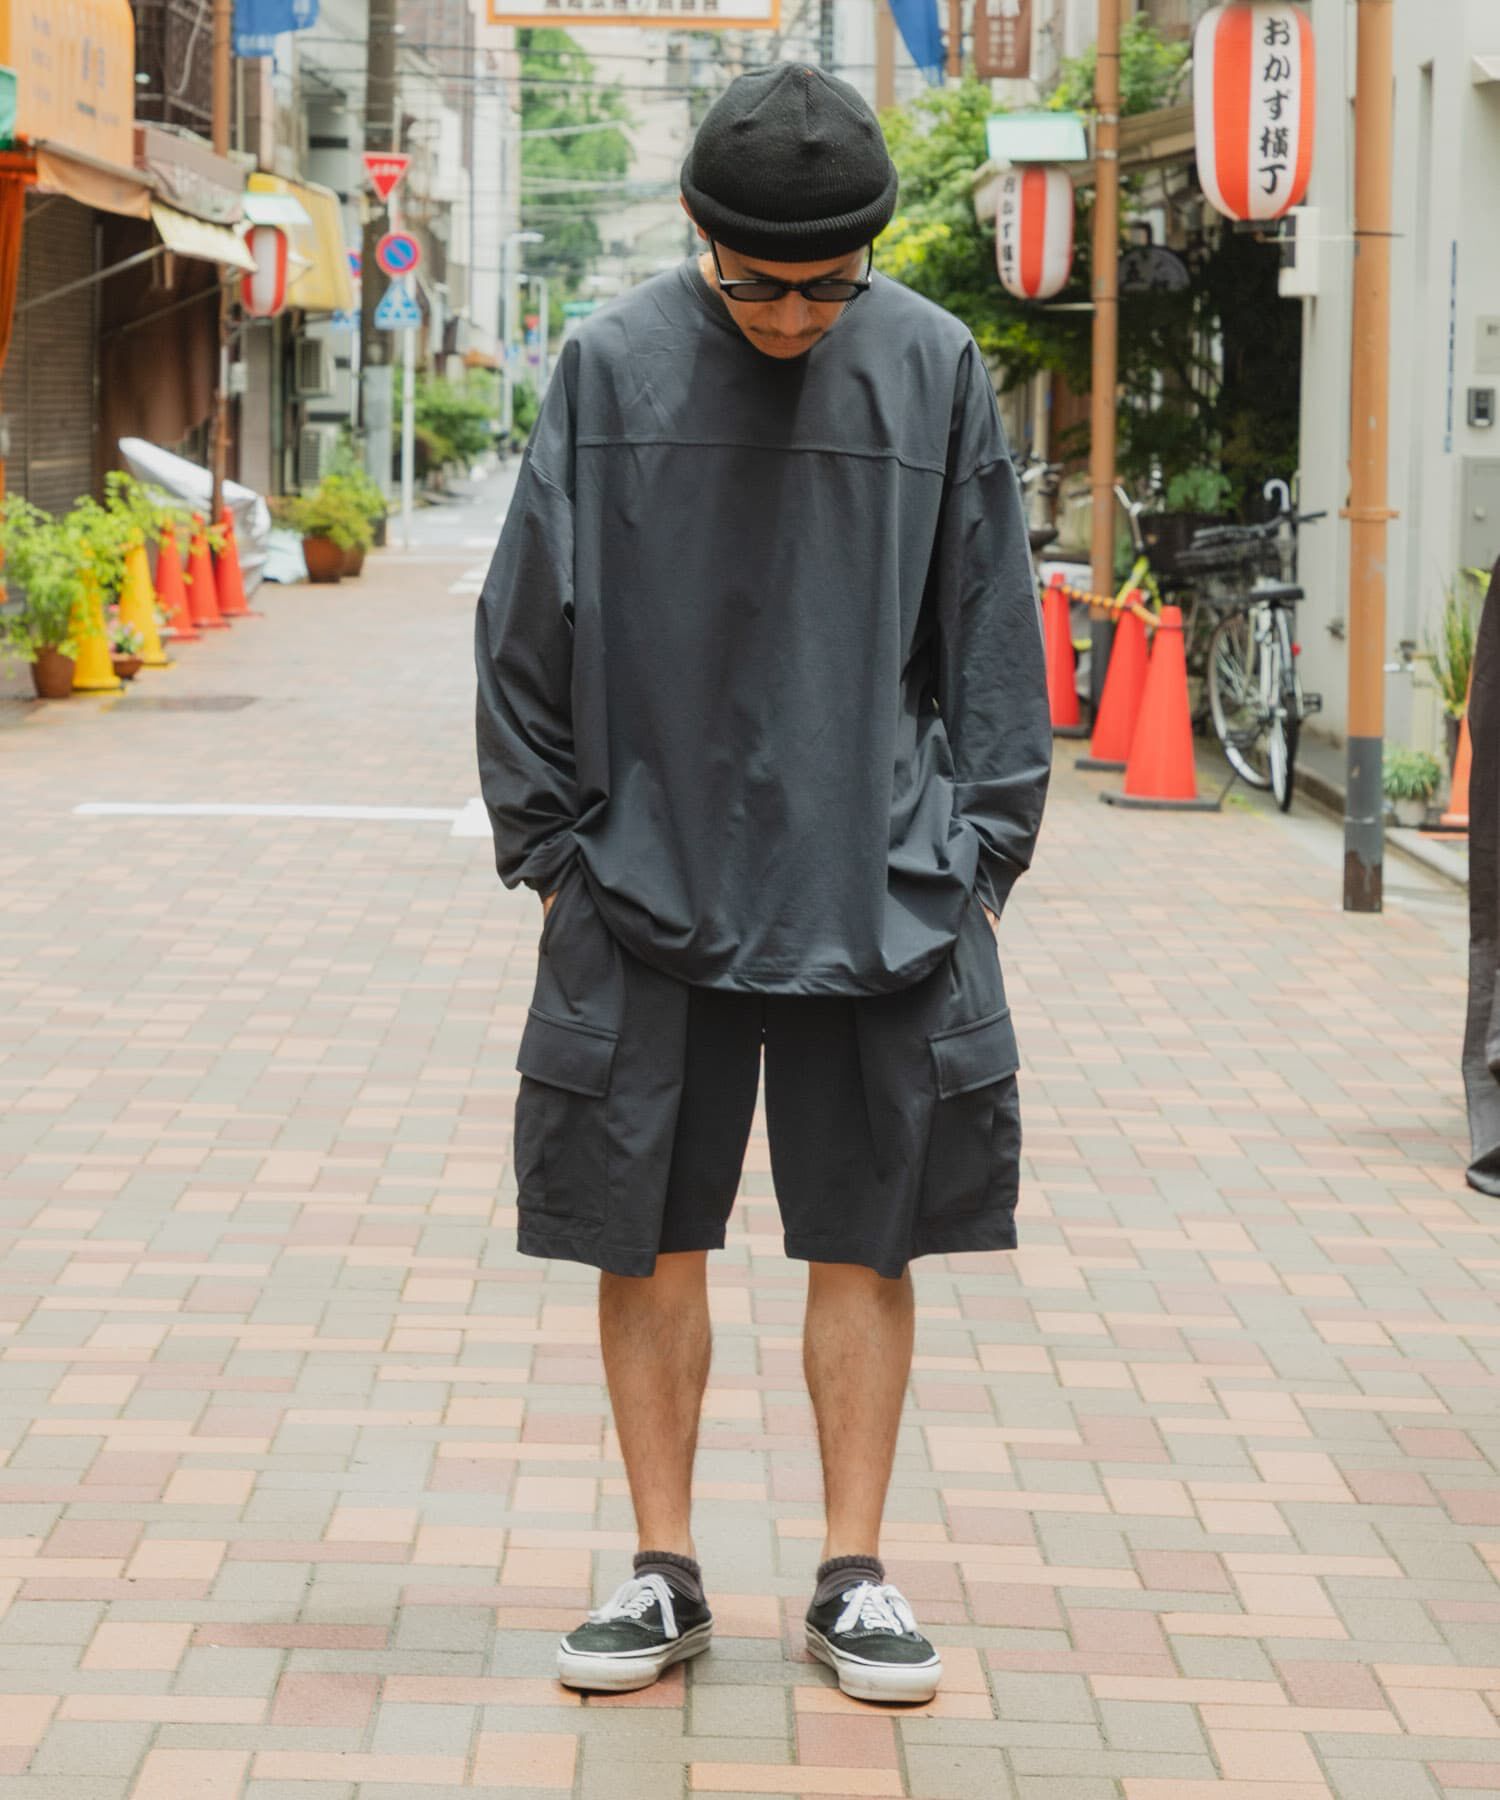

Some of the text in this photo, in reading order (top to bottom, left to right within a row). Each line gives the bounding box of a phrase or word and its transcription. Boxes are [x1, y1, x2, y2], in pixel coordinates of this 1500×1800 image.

[1258, 17, 1290, 195] おかず横丁
